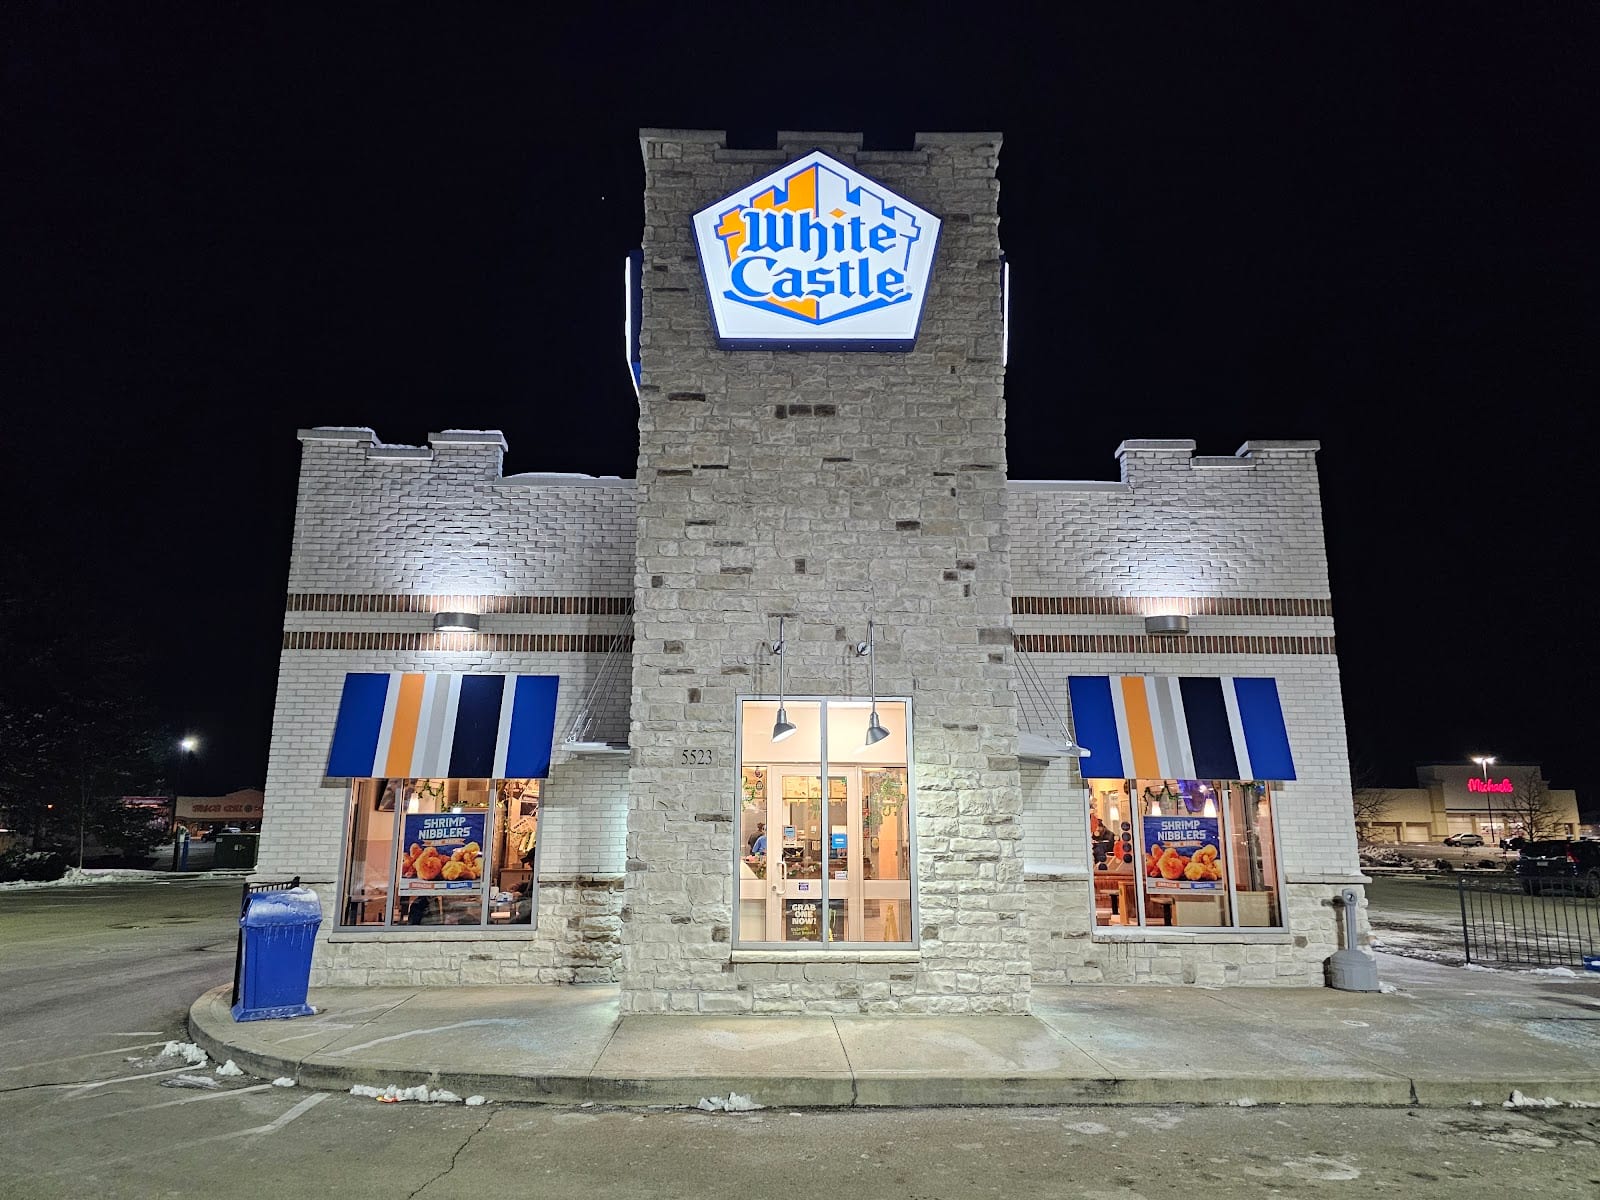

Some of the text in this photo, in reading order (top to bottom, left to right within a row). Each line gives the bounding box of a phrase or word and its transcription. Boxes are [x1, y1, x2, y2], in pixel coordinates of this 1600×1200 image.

[742, 208, 897, 261] White
[731, 256, 905, 299] Castle
[681, 749, 713, 765] 5523
[1467, 778, 1514, 793] Michaels
[423, 816, 466, 829] SHRIMP
[1161, 820, 1200, 831] SHRIMP
[418, 826, 472, 840] NIBBLERS
[1157, 830, 1207, 841] NIBBLERS
[791, 903, 817, 911] GRAB
[794, 910, 814, 918] ONE
[791, 917, 817, 925] NOW!
